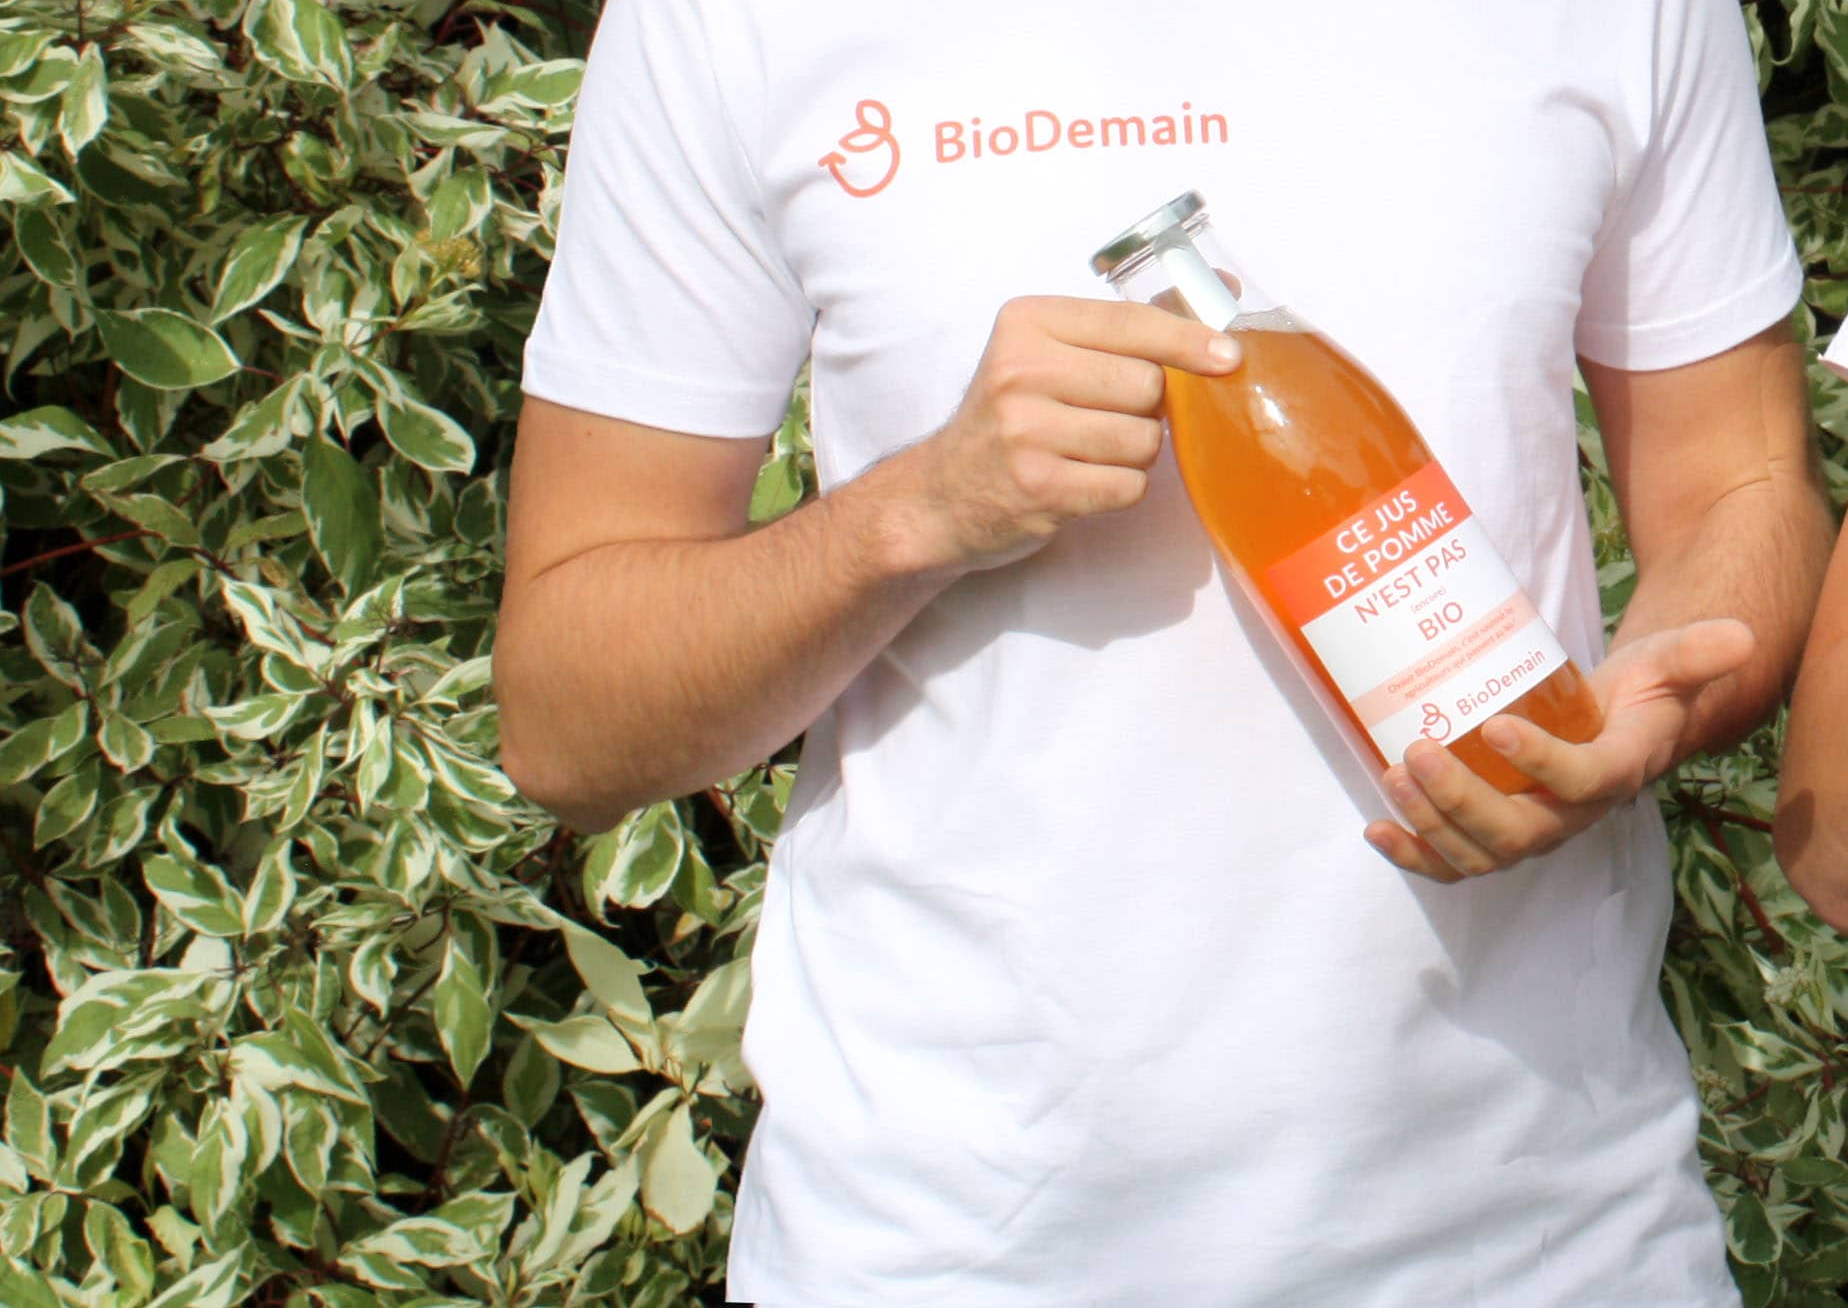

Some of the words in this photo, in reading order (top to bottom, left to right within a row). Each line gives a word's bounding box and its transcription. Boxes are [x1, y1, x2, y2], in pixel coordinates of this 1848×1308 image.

[934, 101, 1229, 163] BioDemain
[1323, 562, 1365, 599] DE
[1363, 501, 1454, 574] POMME
[1336, 519, 1375, 554] CE
[1375, 490, 1417, 532] JUS
[1354, 565, 1422, 624] N'EST
[1424, 539, 1466, 578] PAS
[1418, 602, 1463, 641] BIO
[1456, 649, 1546, 717] BioDemain
